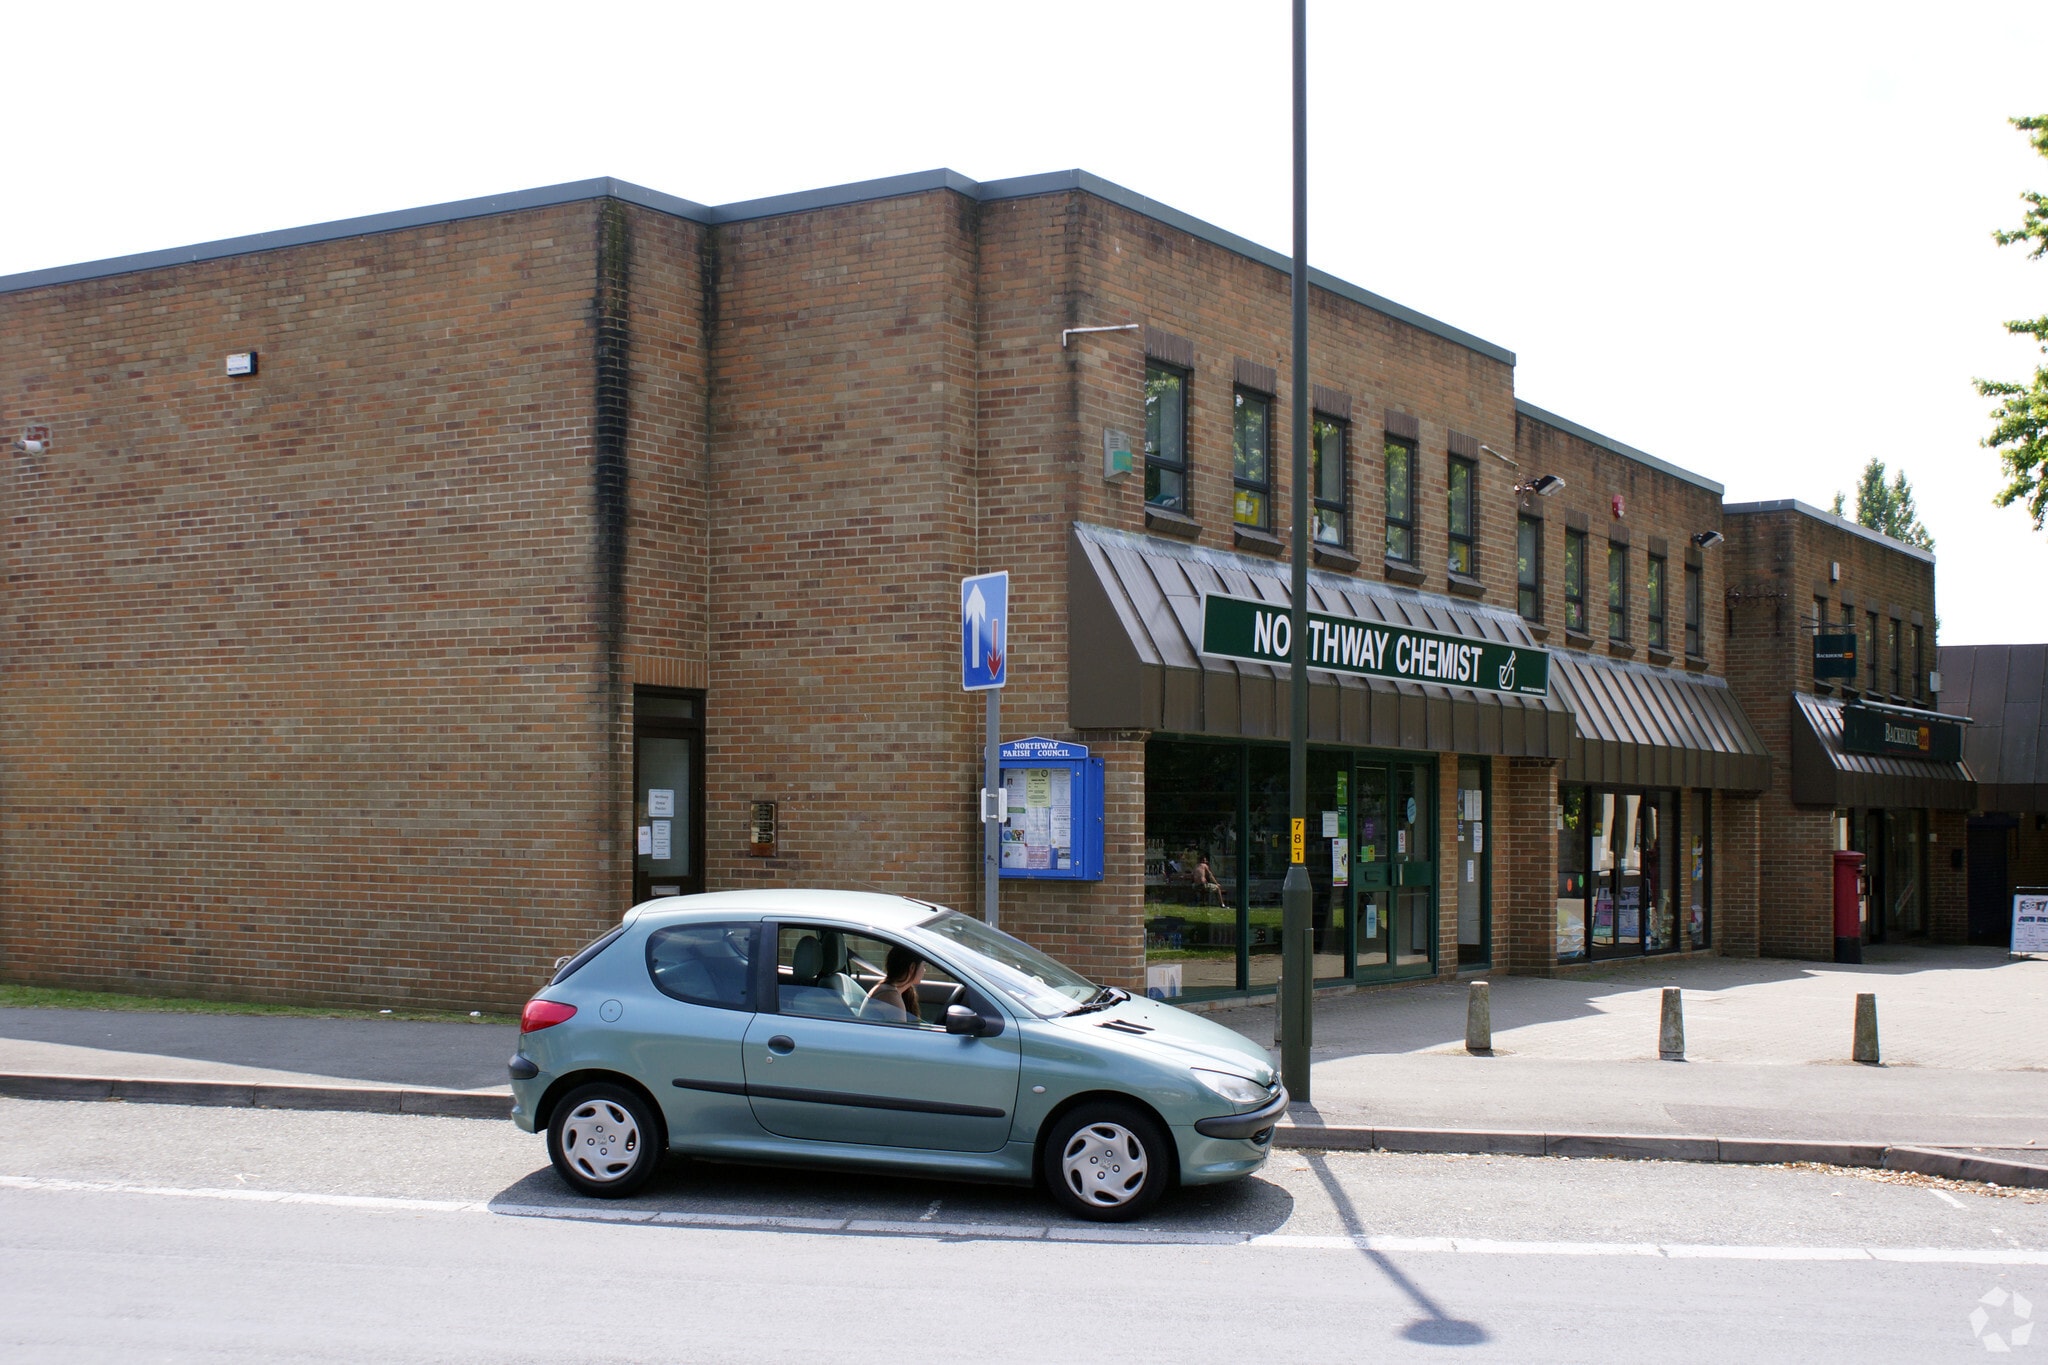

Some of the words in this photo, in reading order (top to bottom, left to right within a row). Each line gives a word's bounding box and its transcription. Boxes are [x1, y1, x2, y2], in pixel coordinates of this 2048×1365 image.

[1253, 610, 1390, 670] NOTHWAY
[1395, 634, 1483, 683] CHEMIST
[1014, 742, 1059, 750] NORTHWAY
[1885, 722, 1919, 746] BACKHOUSE
